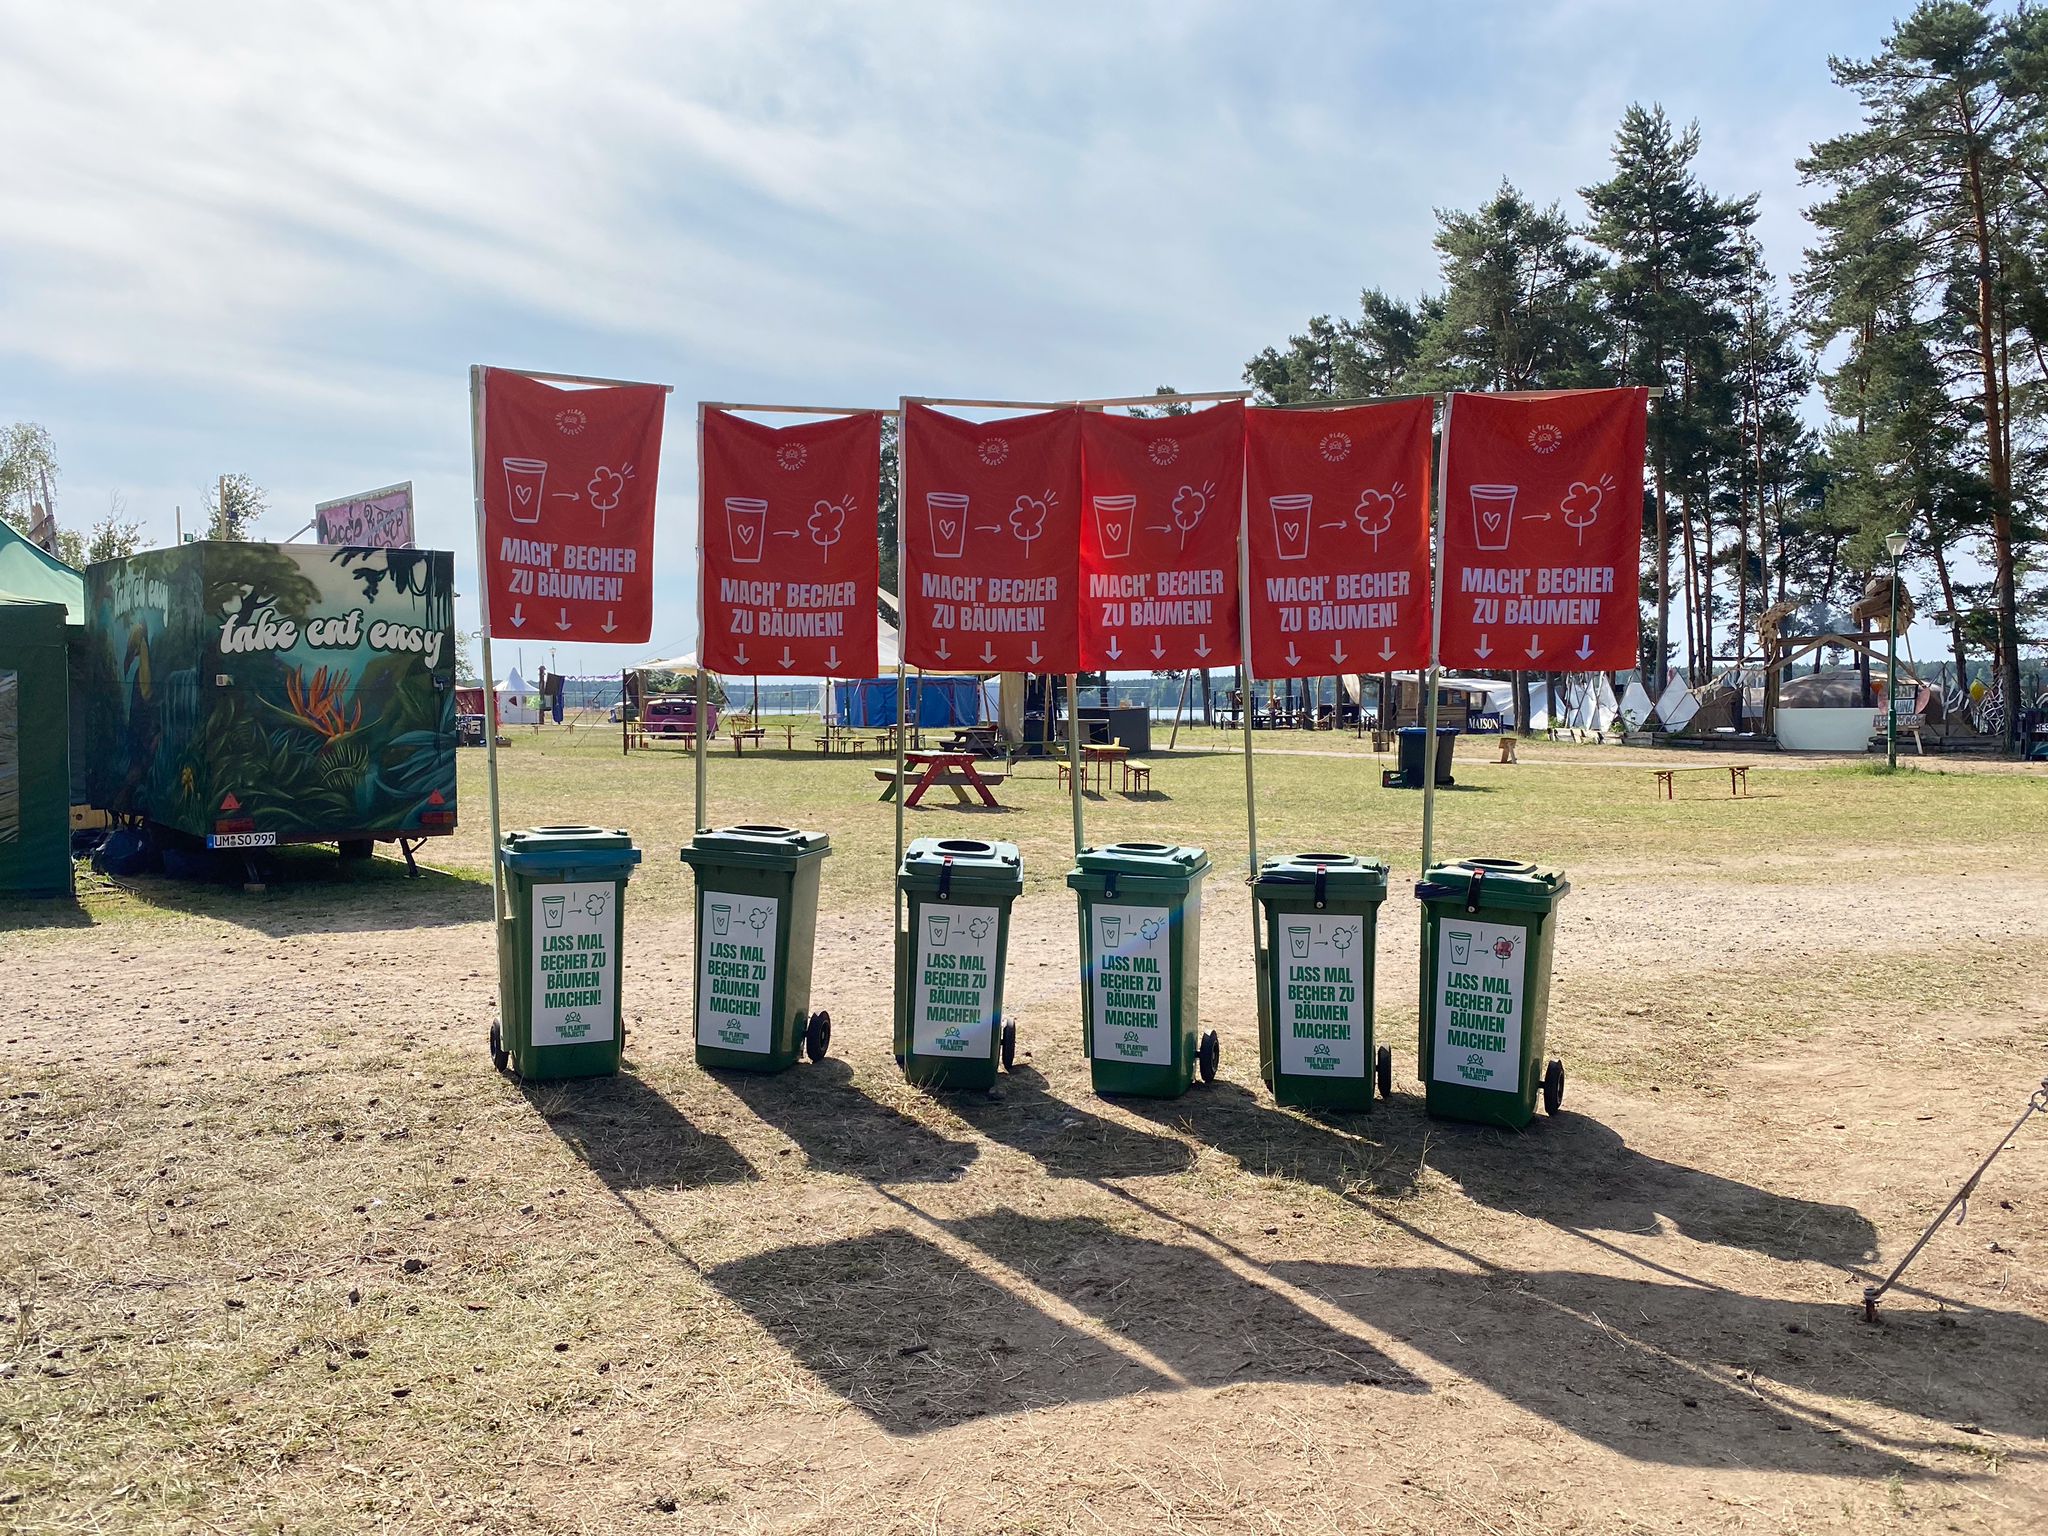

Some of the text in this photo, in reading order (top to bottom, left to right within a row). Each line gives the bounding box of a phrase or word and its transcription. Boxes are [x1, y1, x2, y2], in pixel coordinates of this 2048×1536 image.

[563, 546, 636, 572] BECHER
[509, 568, 623, 601] ZU BÄUMEN!
[988, 576, 1057, 602] BECHER
[1157, 570, 1224, 596] BECHER
[1336, 572, 1410, 599] BECHER
[1537, 568, 1614, 593] BECHER
[786, 582, 856, 607] BECHER
[932, 602, 1044, 632] ZU BÄUMEN!
[1102, 597, 1212, 627] ZU BÄUMEN!
[1280, 601, 1398, 632] ZU BÄUMEN!
[1473, 595, 1600, 625] ZU BÄUMEN!
[730, 607, 843, 637] ZU BÄUMEN!
[219, 607, 444, 668] take eat easy
[1468, 718, 1499, 729] MAISON
[255, 834, 274, 844] 999
[543, 934, 604, 952] LASS MAL
[710, 942, 765, 961] LASS MAL
[541, 952, 606, 970] BECHER ZU
[708, 960, 766, 980] BECHER ZU
[927, 953, 986, 971] LASS MAL
[1102, 955, 1159, 973] LASS MAL
[547, 969, 599, 989] BÄUMEN
[925, 971, 987, 989] BECHER ZU
[1101, 974, 1161, 991] BECHER ZU
[1290, 966, 1353, 983] LASS MAL
[1448, 972, 1511, 995] LASS MAL
[712, 976, 759, 998] BÄUMEN
[930, 986, 979, 1006] BÄUMEN
[1288, 985, 1354, 1002] BECHER ZU
[545, 990, 601, 1008] MACHEN!
[710, 997, 760, 1016] MACHEN!
[1107, 988, 1155, 1010] BÄUMEN
[1445, 990, 1512, 1013] BECHER ZU
[927, 1007, 980, 1023] MACHEN!
[1105, 1010, 1158, 1028] MACHEN!
[1295, 1001, 1348, 1021] BÄUMEN
[1450, 1007, 1504, 1033] BÄUMEN
[1293, 1023, 1350, 1040] MACHEN!
[1448, 1029, 1506, 1053] MACHEN!
